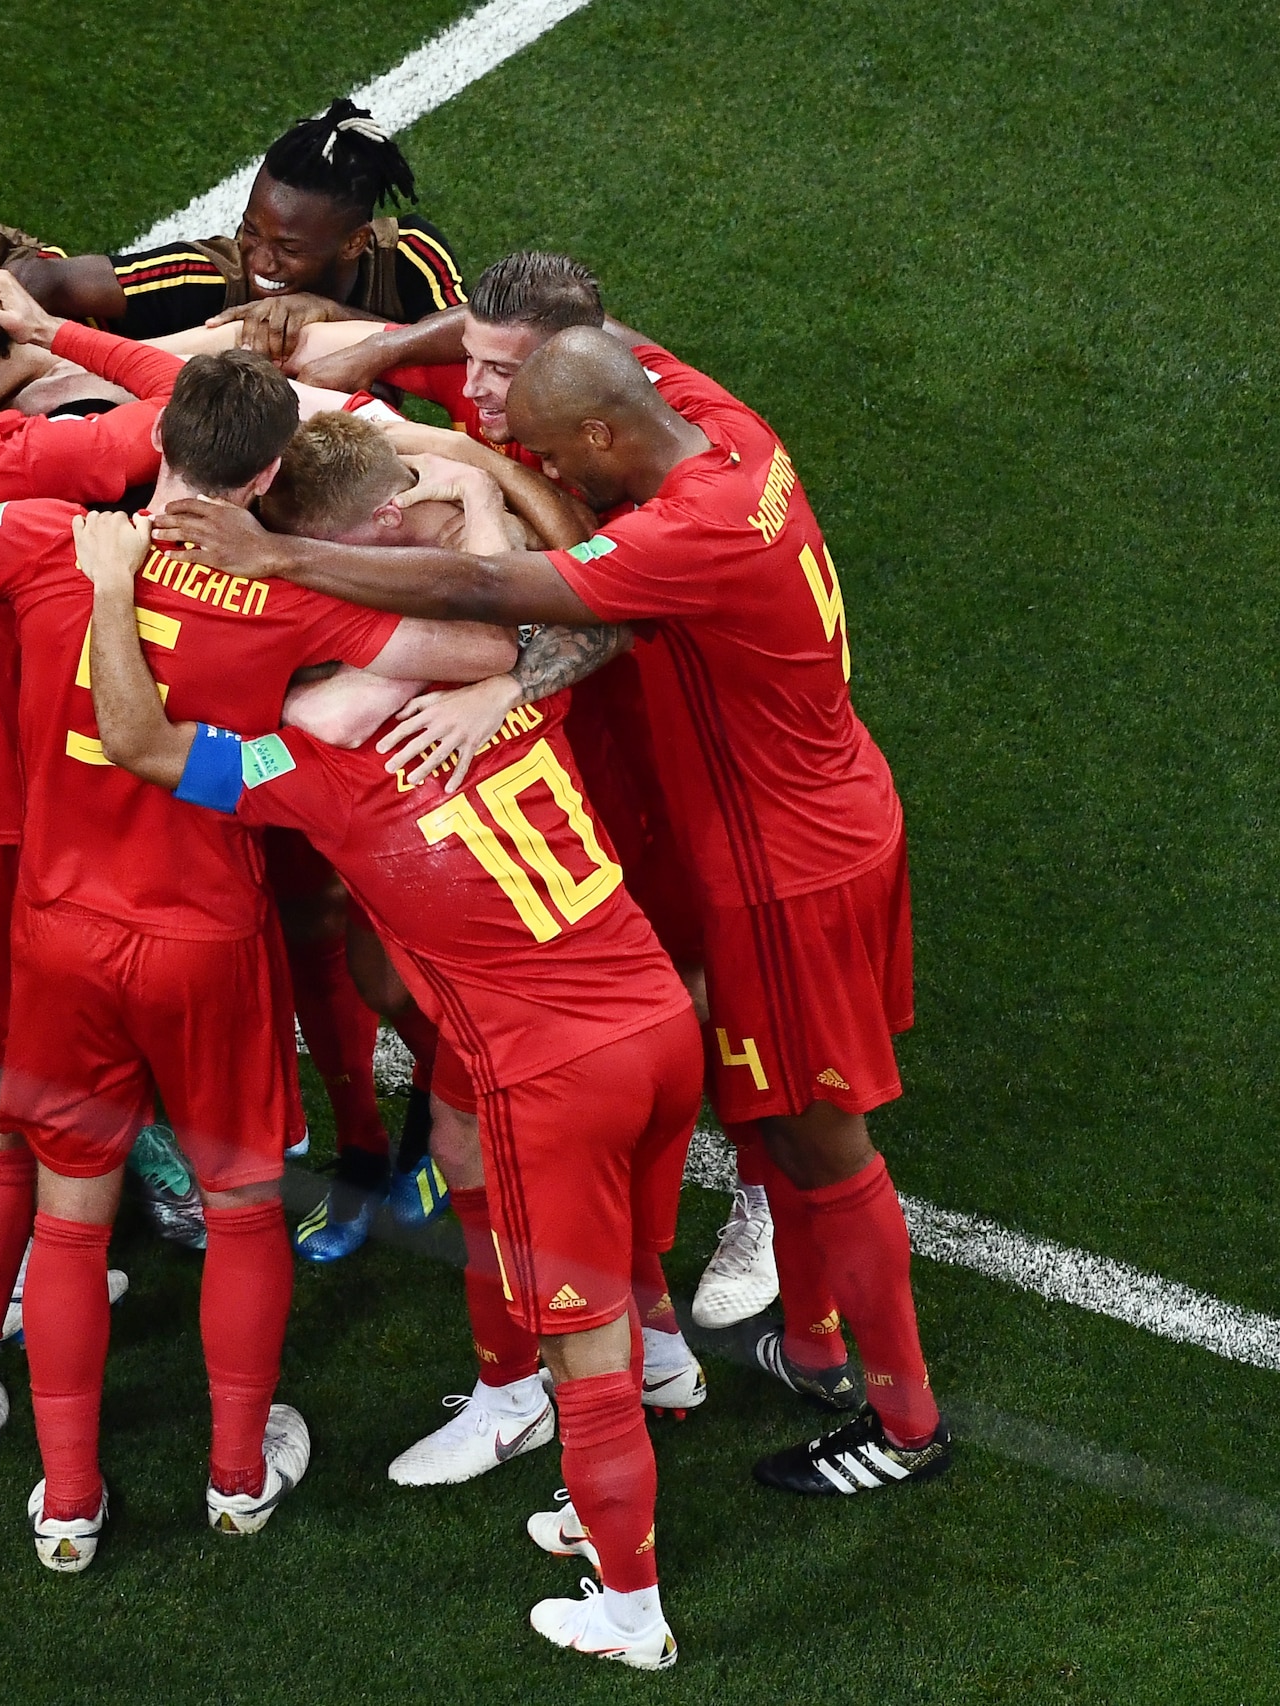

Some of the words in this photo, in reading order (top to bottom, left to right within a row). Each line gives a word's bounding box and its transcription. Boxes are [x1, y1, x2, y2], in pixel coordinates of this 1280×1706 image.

[141, 549, 270, 616] ONGHEN
[799, 543, 851, 684] 4
[417, 738, 624, 943] 10
[716, 1028, 769, 1091] 4
[816, 1076, 850, 1090] adidas
[549, 1298, 588, 1310] adidas
